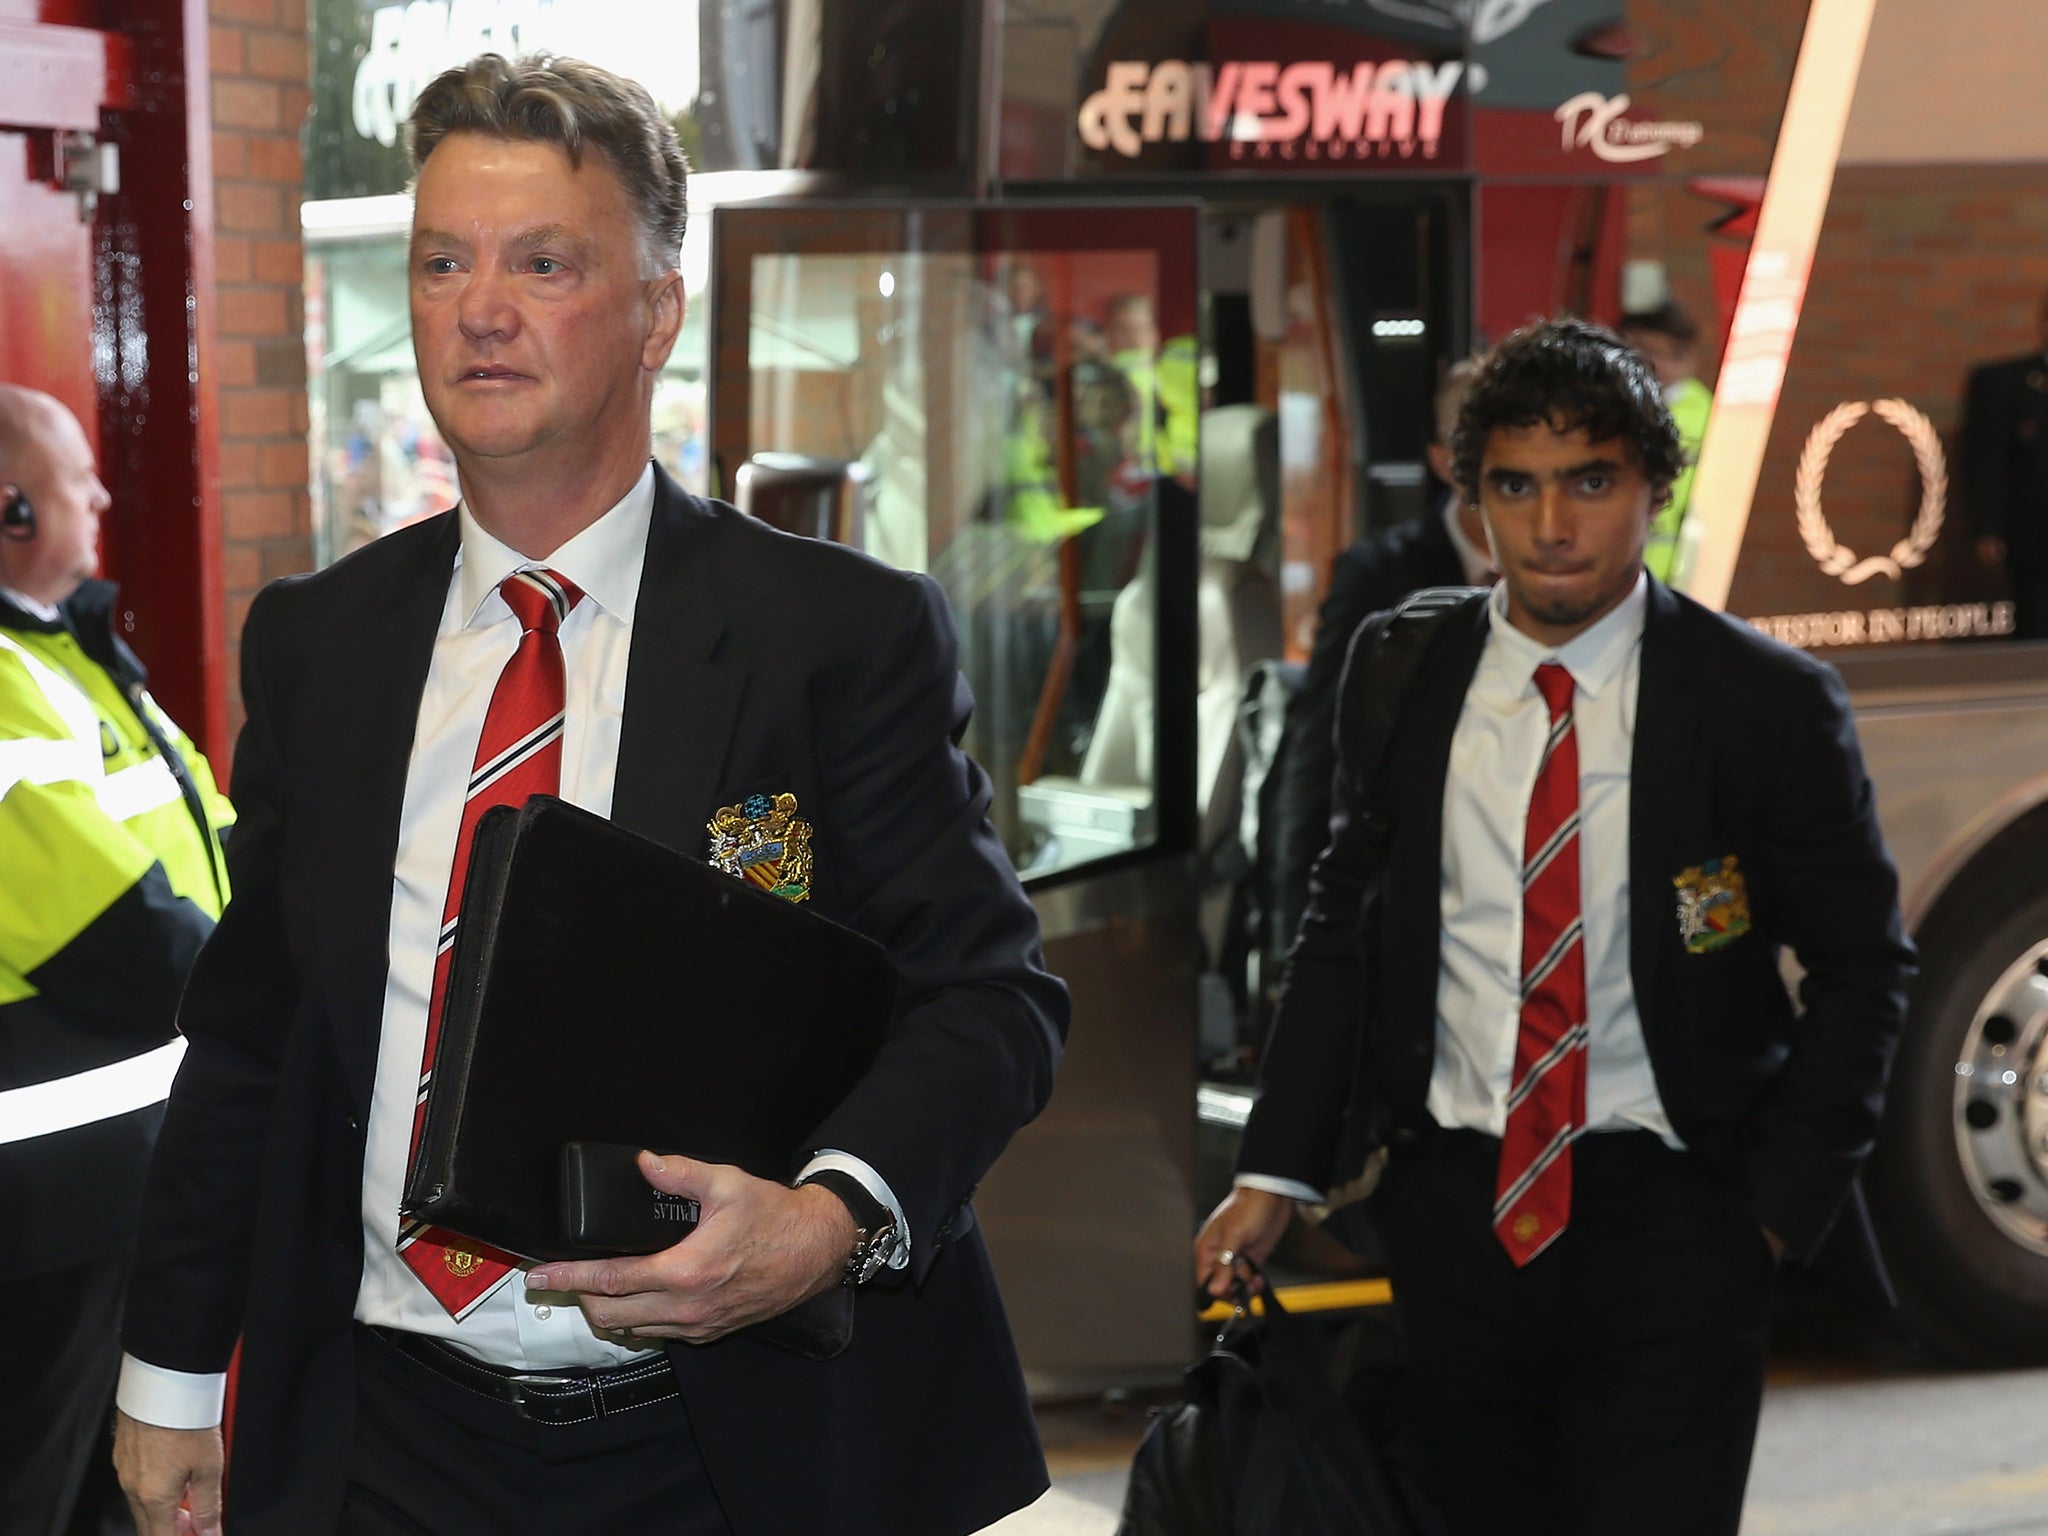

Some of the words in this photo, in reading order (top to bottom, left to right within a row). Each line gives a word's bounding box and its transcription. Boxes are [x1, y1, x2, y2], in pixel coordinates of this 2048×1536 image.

[1078, 60, 1464, 157] EAVESWAY
[1229, 138, 1440, 160] EXCLUSIVE
[1907, 600, 2016, 640] PEOPLE
